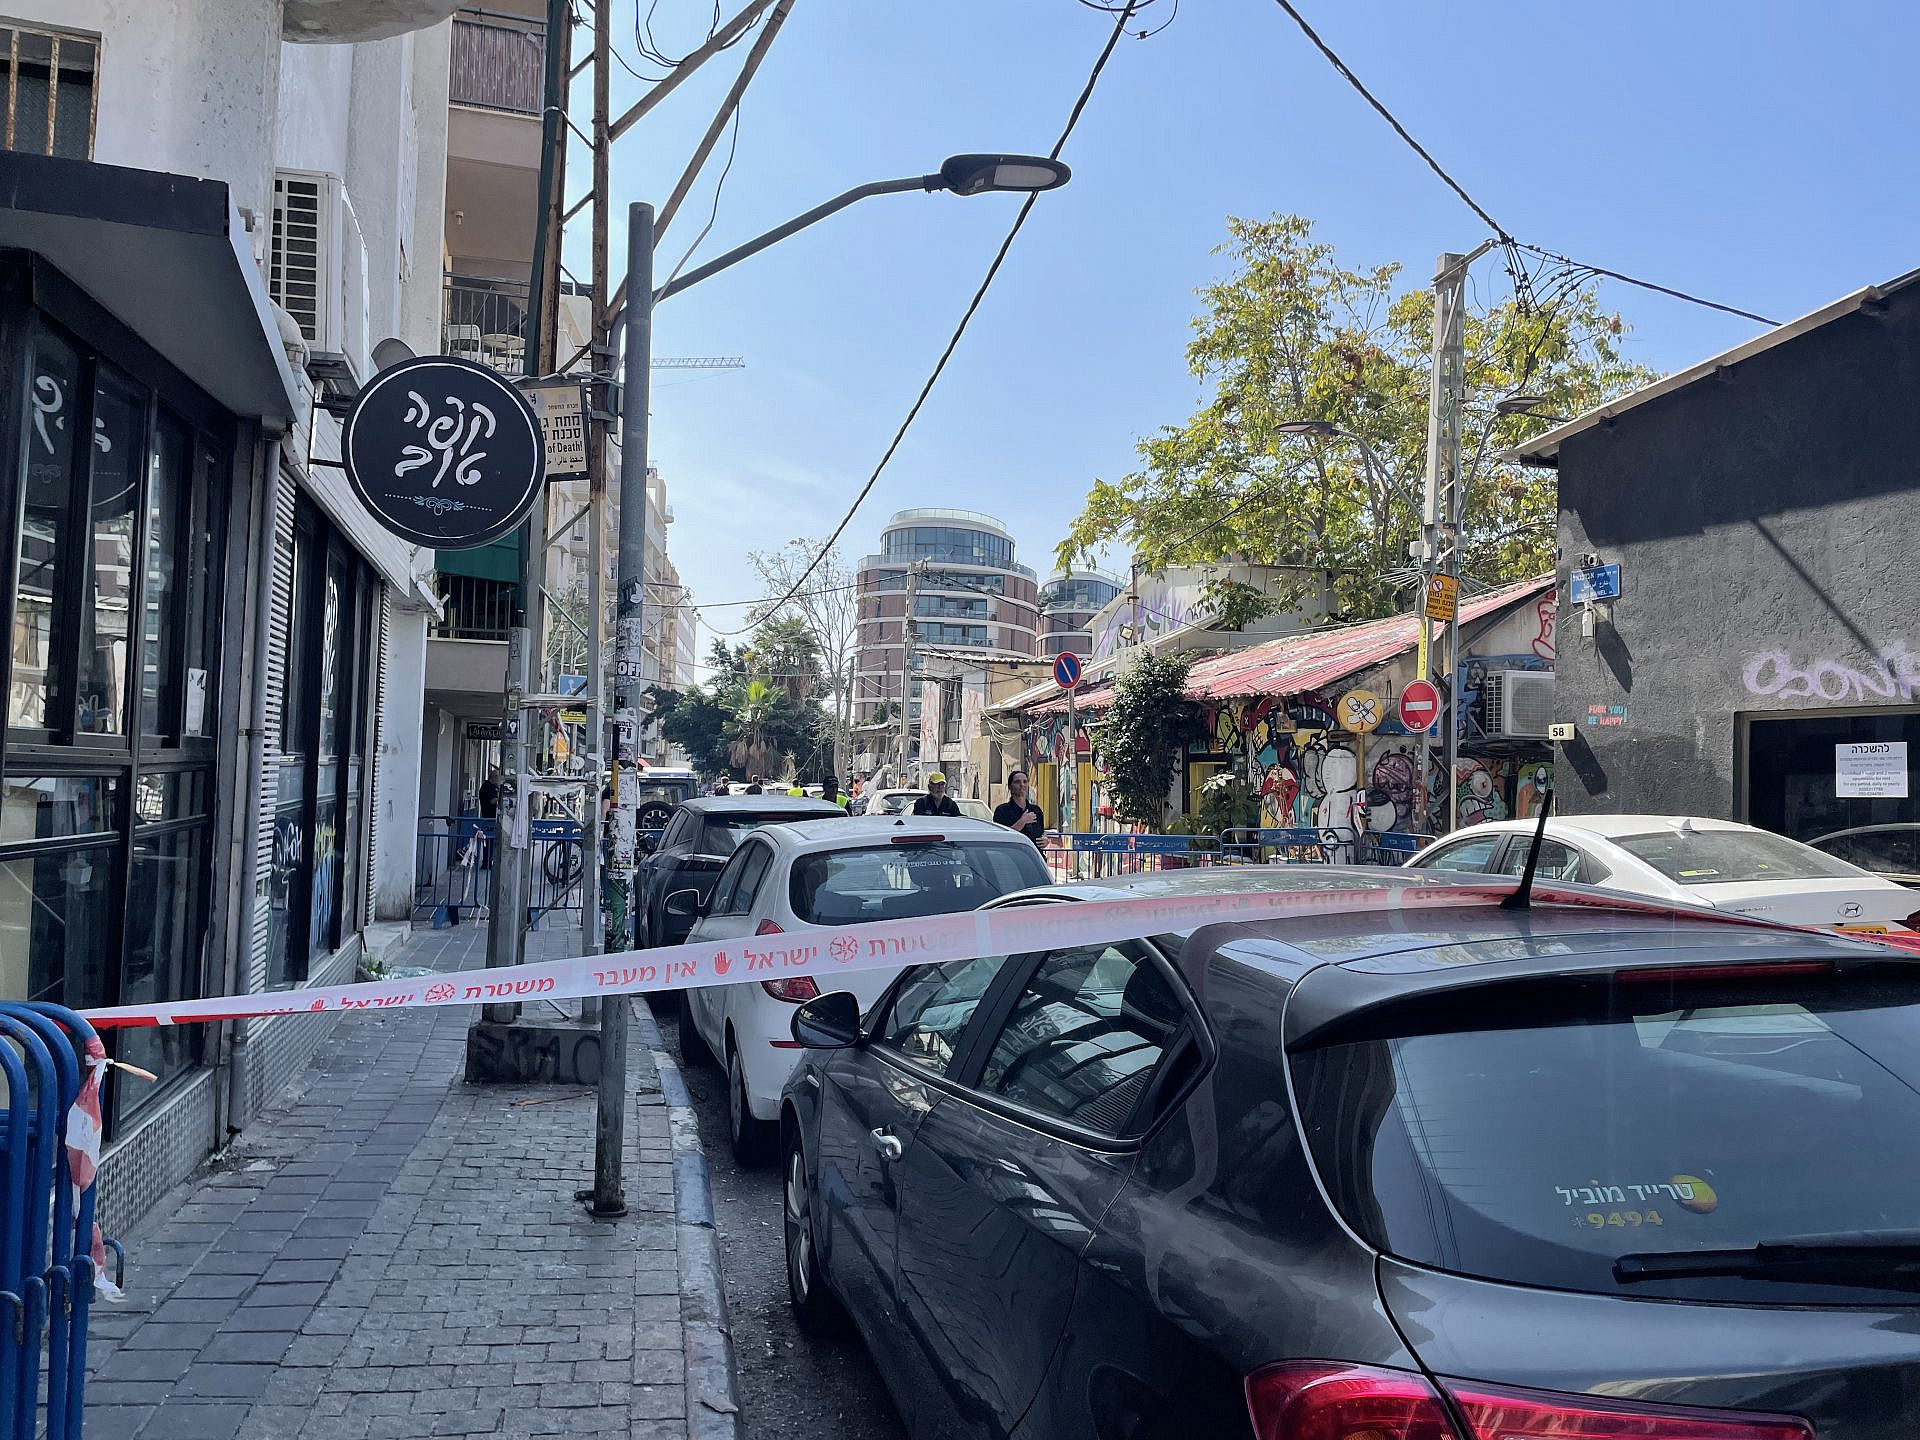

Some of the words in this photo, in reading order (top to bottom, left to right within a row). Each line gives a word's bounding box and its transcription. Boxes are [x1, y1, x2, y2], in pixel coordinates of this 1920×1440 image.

[554, 415, 581, 428] מתח
[552, 427, 581, 441] סכנת
[547, 442, 556, 453] of
[557, 440, 583, 453] Death!
[394, 445, 487, 489] טוב
[1552, 727, 1565, 737] 58
[1851, 743, 1890, 754] להשכרה
[743, 946, 817, 971] ישראל
[593, 963, 656, 987] מעבר
[663, 959, 697, 984] אין
[464, 976, 555, 1000] משטרת
[1554, 1184, 1627, 1207] מוביל
